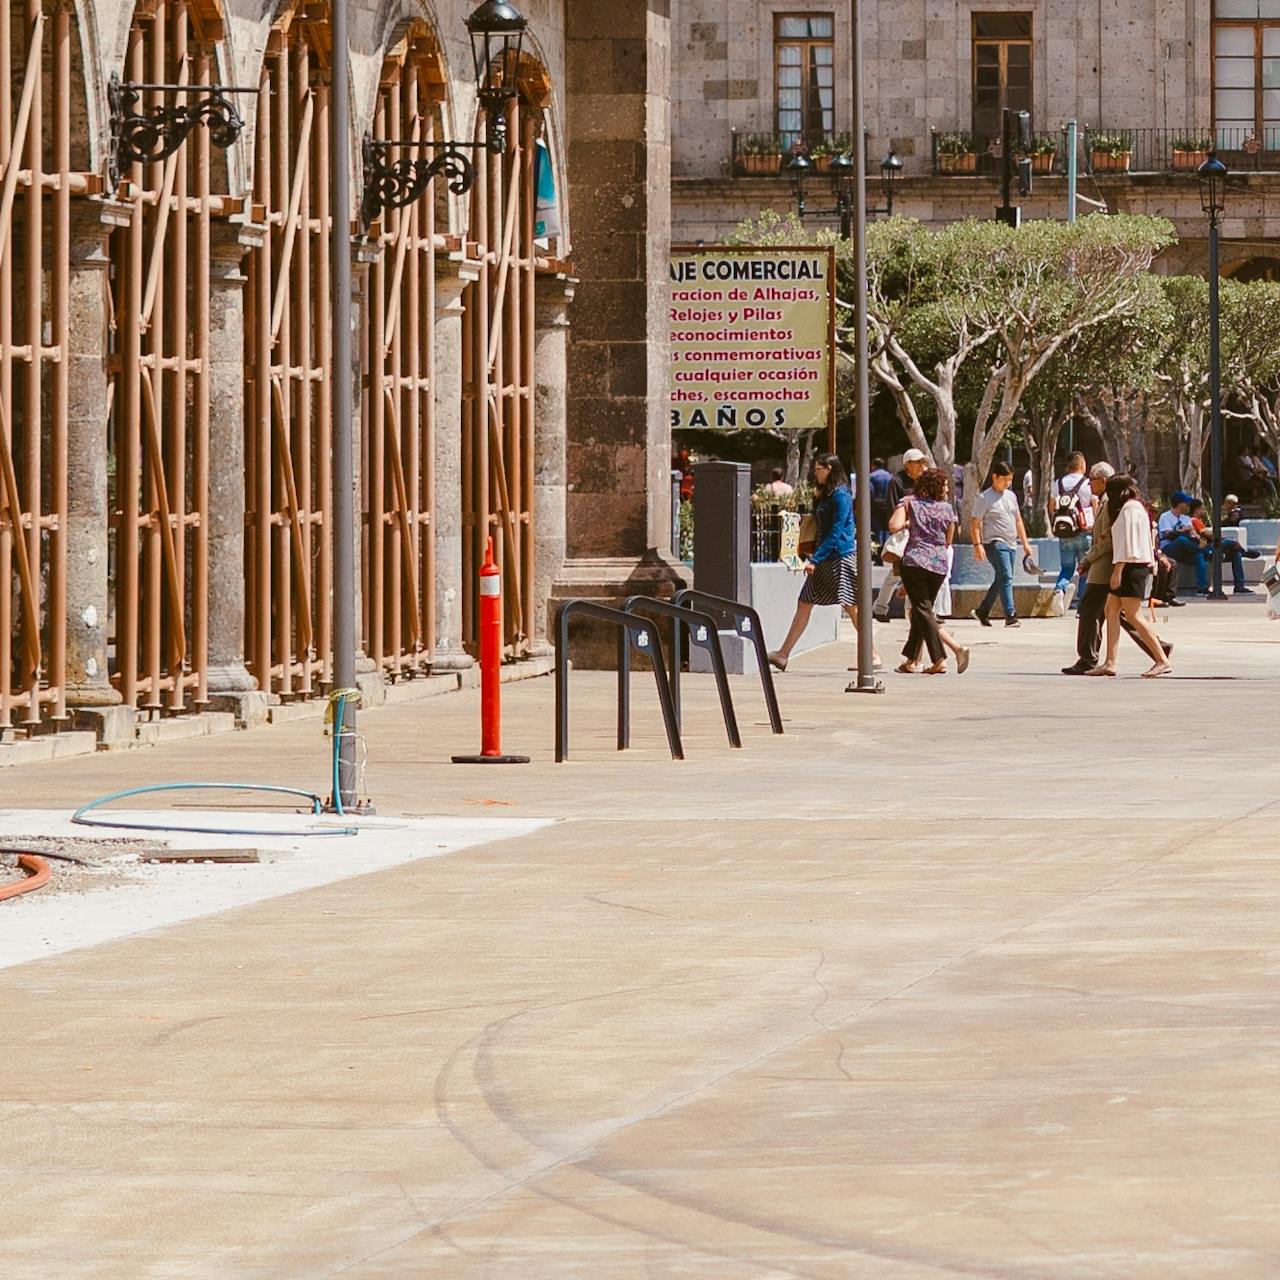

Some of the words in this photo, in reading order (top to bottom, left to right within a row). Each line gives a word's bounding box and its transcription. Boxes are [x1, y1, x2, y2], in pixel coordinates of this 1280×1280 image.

[703, 260, 824, 280] COMERCIAL
[728, 288, 748, 301] de
[753, 288, 820, 302] Alhajas,
[670, 309, 723, 323] Relojes
[728, 313, 738, 323] y
[743, 308, 782, 321] Pilas
[685, 348, 821, 361] conmemorativas
[675, 369, 754, 383] cualquier
[758, 367, 818, 380] ocasión
[714, 388, 810, 401] escamochas
